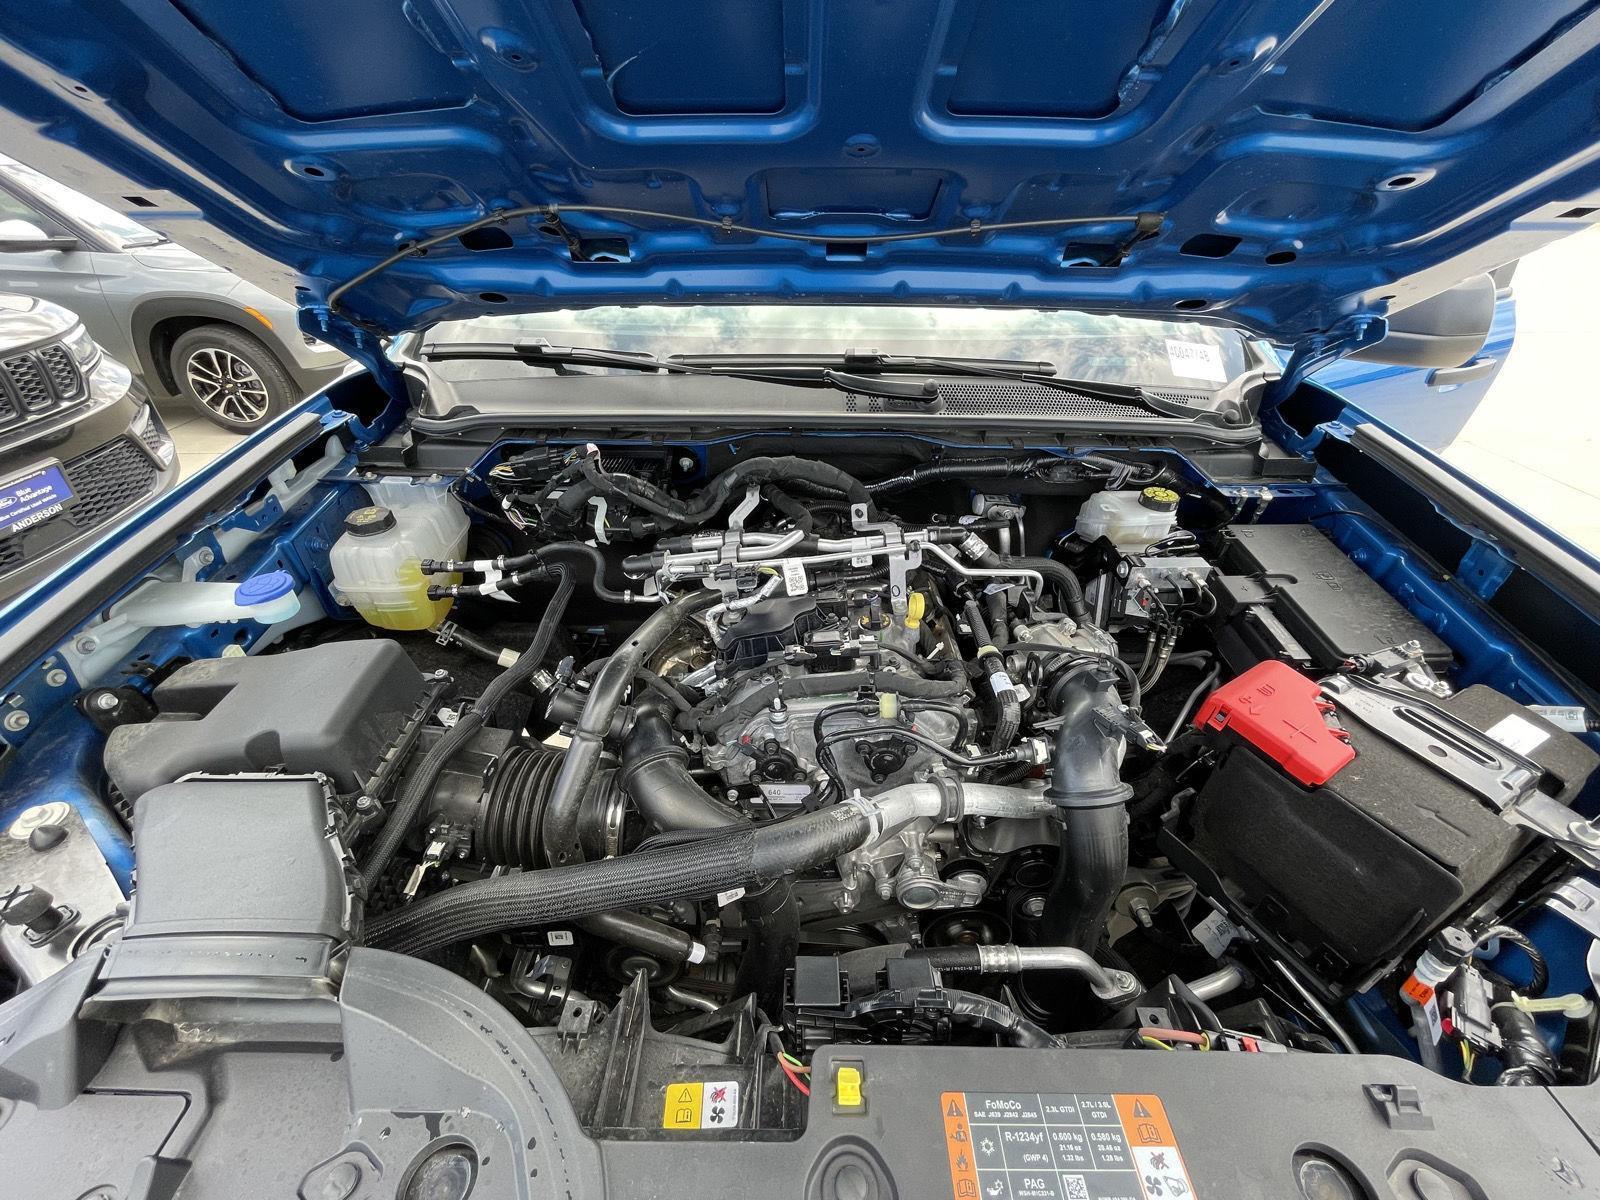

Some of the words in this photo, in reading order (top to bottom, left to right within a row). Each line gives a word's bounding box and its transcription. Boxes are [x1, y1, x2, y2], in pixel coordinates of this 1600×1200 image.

[15, 487, 32, 497] Blue
[20, 485, 53, 503] Advantage
[12, 503, 63, 533] ANDERSON
[985, 1099, 1022, 1110] FoMoCo
[1004, 1131, 1044, 1144] R-1234yf
[1072, 1132, 1083, 1143] kg
[1110, 1132, 1122, 1143] kg
[1023, 1153, 1041, 1163] (GWP
[1041, 1153, 1049, 1163] 4)
[1023, 1178, 1046, 1189] PAG
